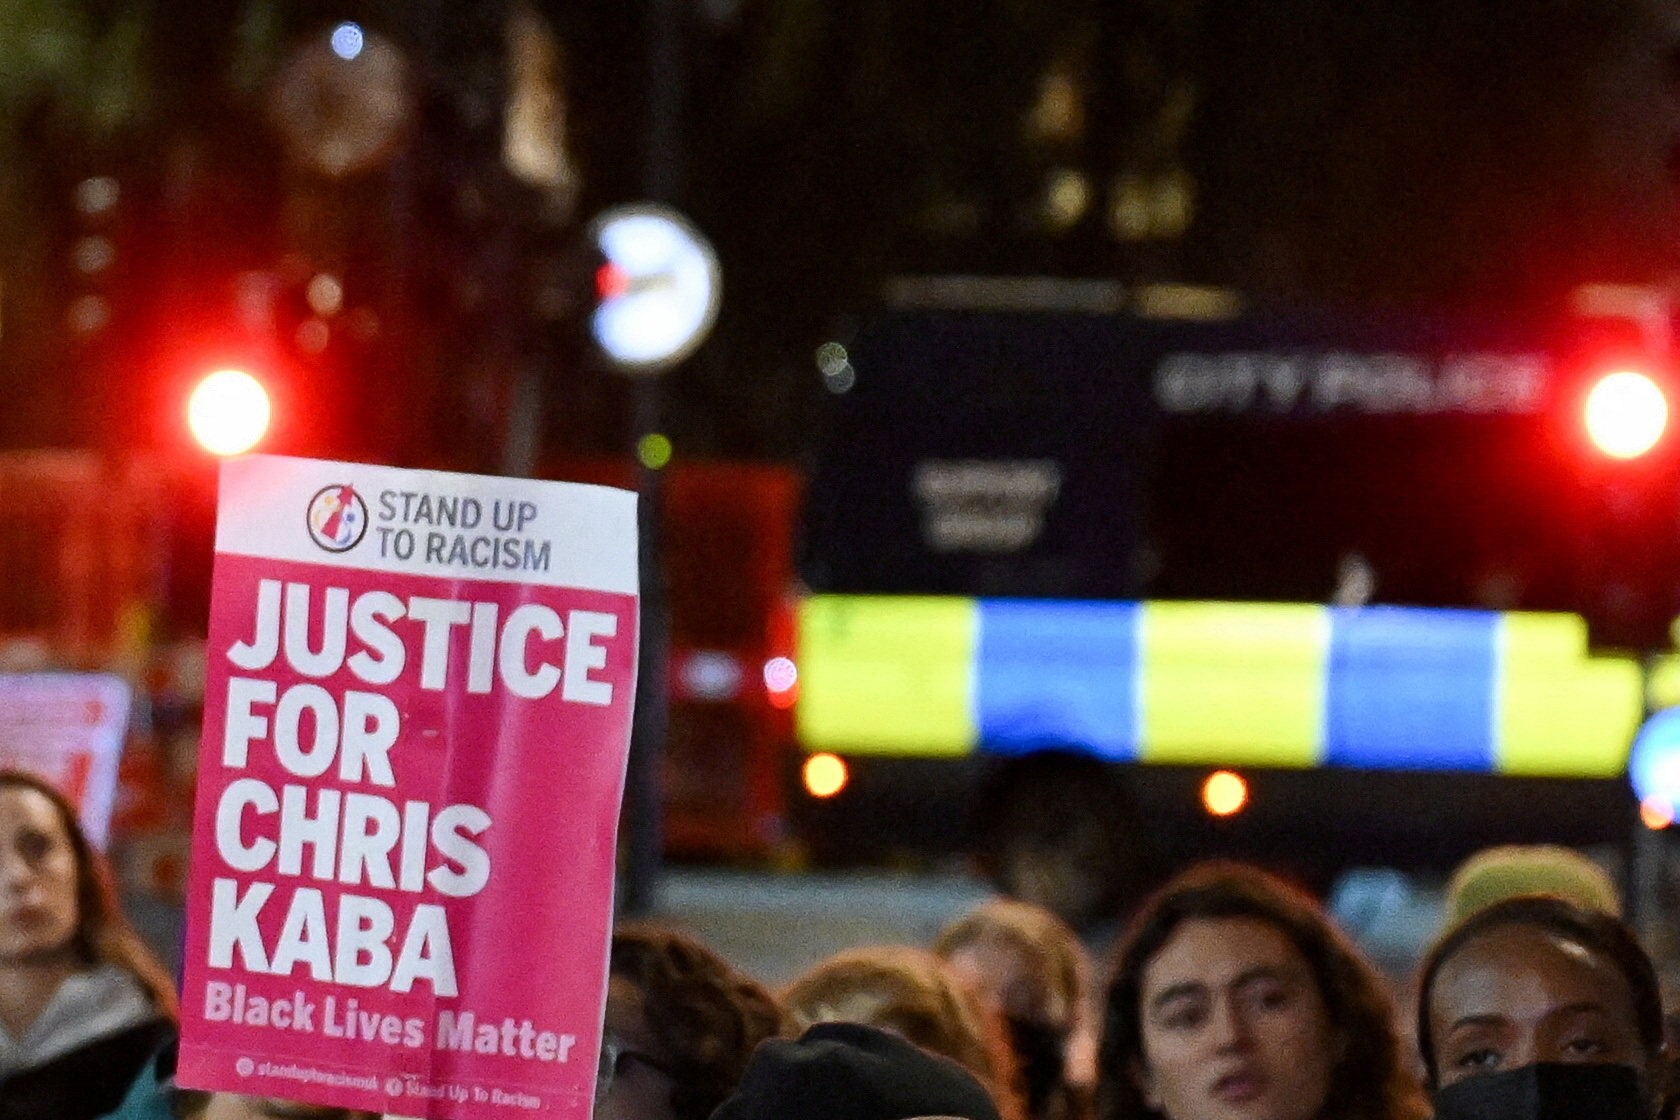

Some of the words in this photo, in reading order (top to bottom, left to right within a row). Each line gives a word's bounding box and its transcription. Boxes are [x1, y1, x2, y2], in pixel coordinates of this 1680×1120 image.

[376, 525, 416, 561] TO
[425, 531, 552, 572] RACISM
[378, 490, 482, 529] STAND
[493, 500, 538, 532] UP
[226, 579, 618, 706] JUSTICE
[224, 676, 400, 787] FOR
[215, 778, 492, 897] CHRIS
[208, 877, 458, 997] KABA
[204, 981, 315, 1032] Black
[323, 995, 426, 1049] Lives
[436, 1009, 576, 1063] Matter
